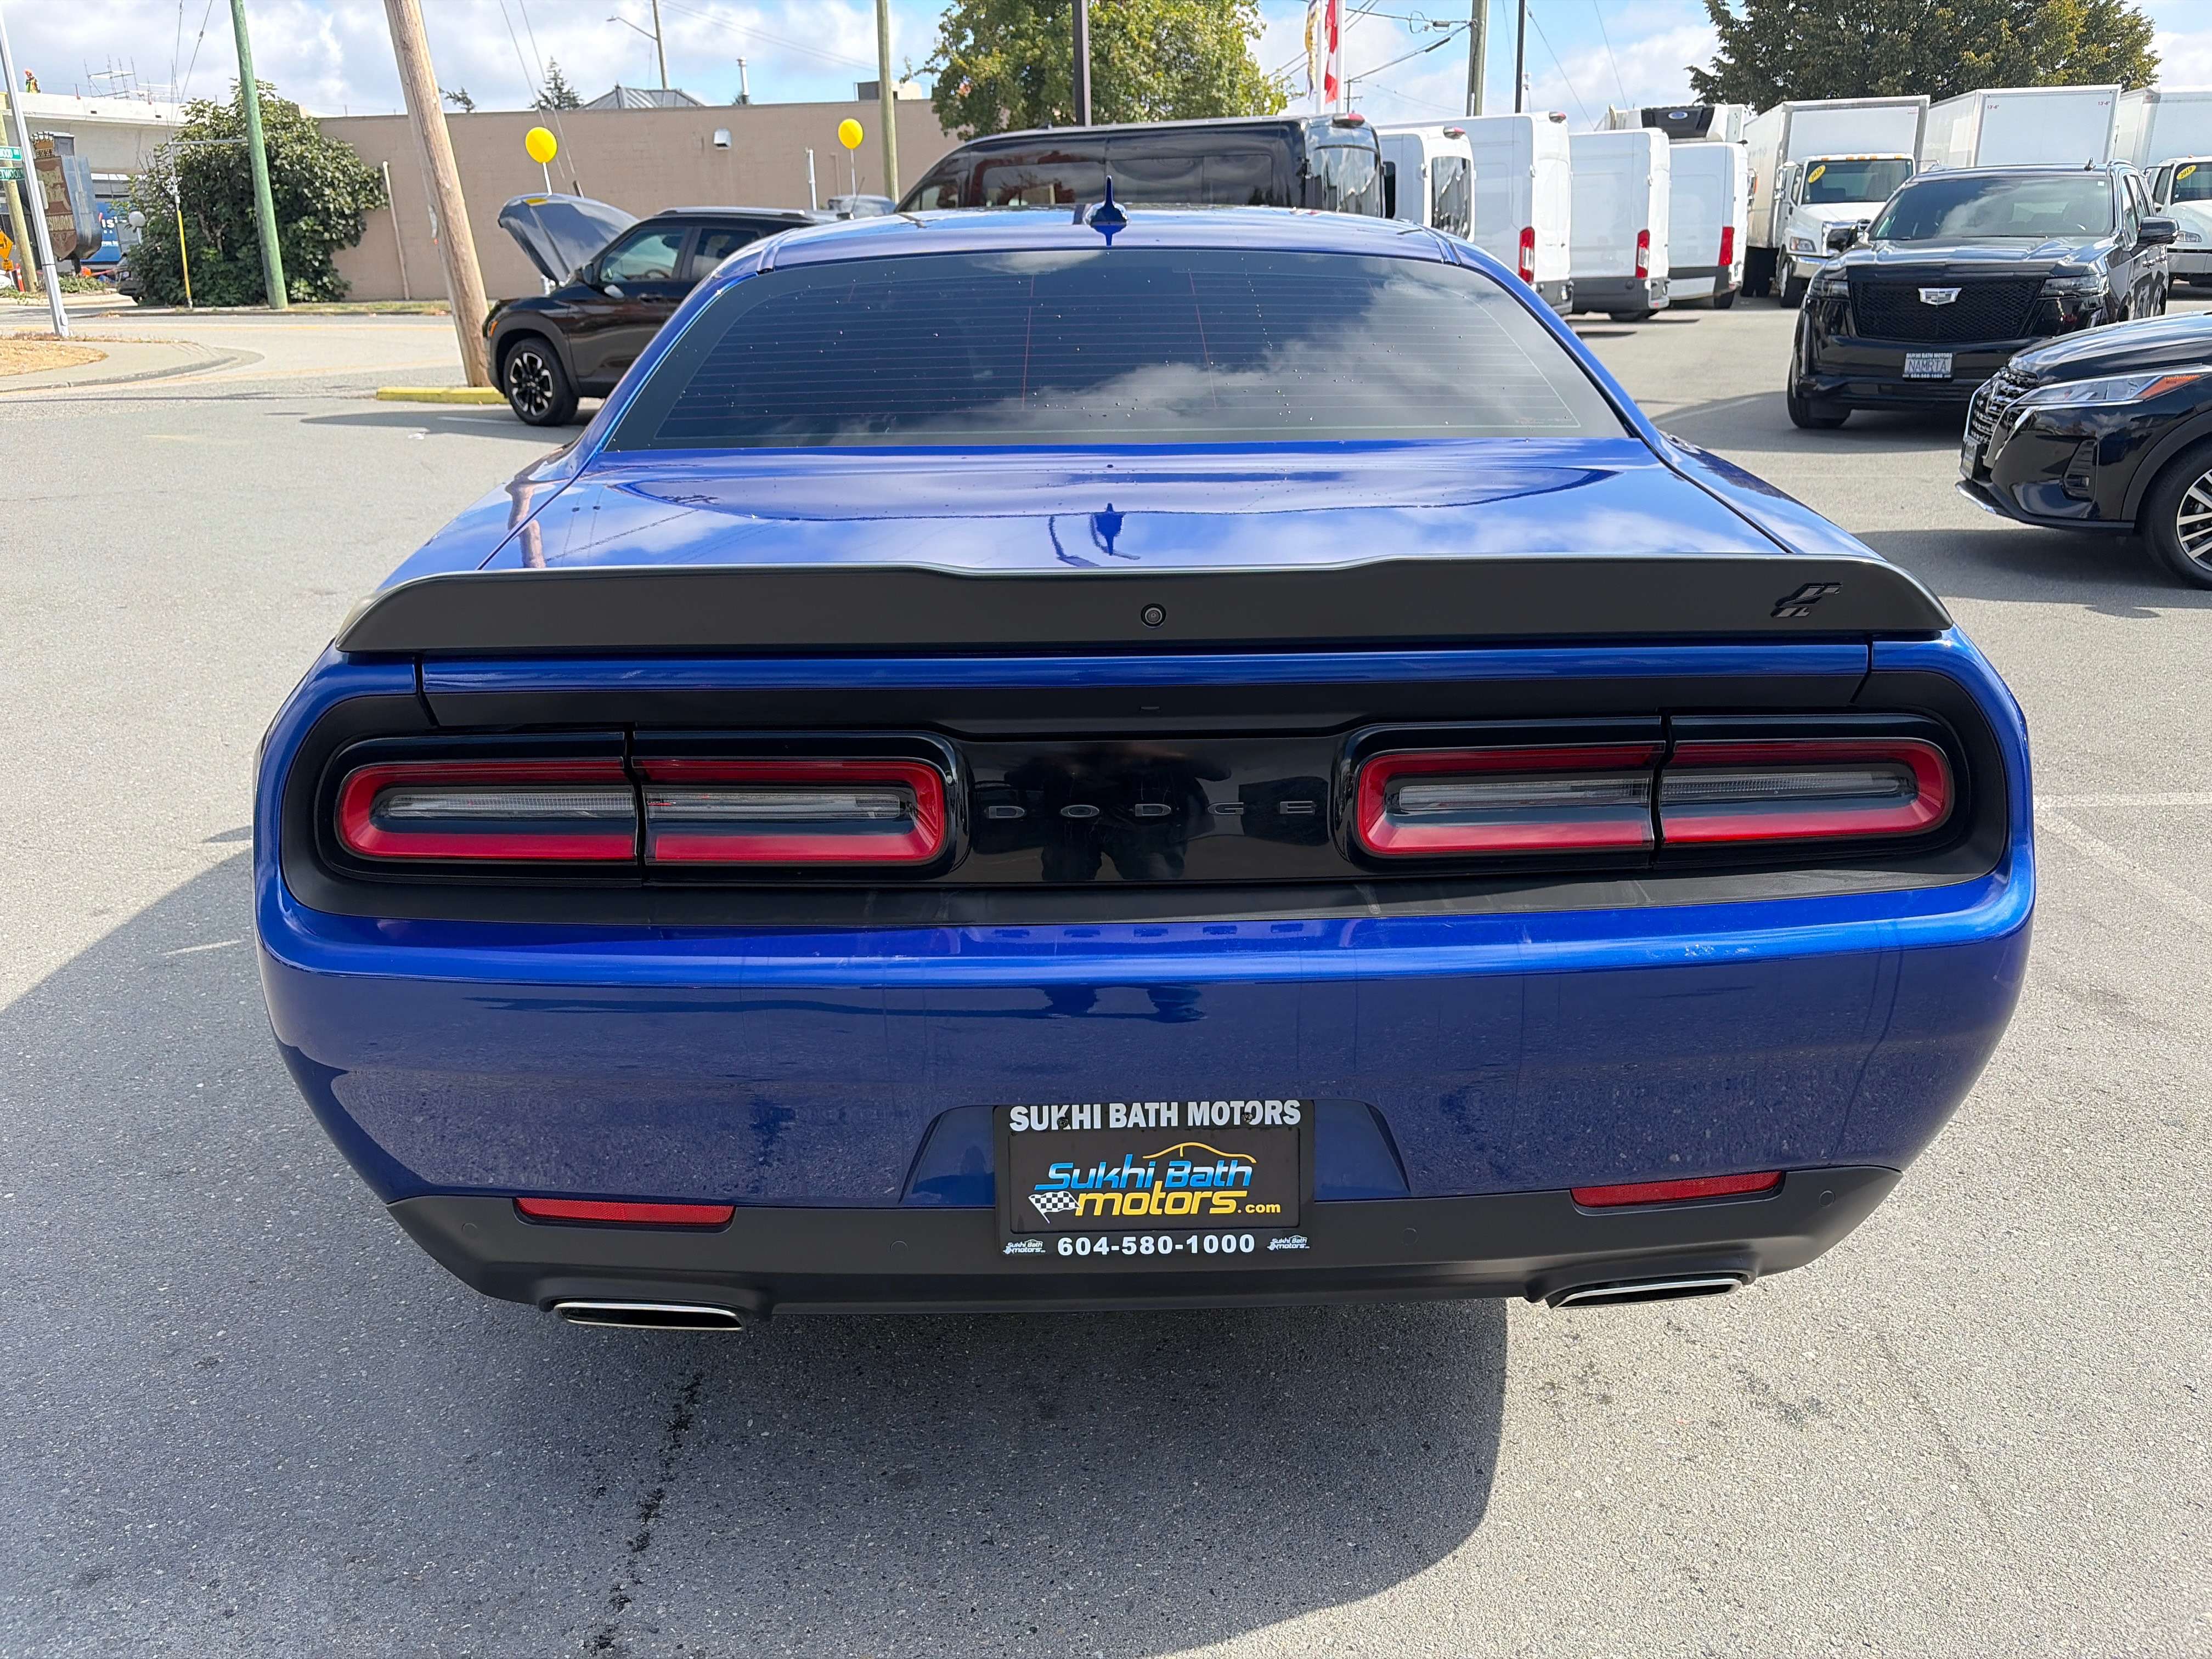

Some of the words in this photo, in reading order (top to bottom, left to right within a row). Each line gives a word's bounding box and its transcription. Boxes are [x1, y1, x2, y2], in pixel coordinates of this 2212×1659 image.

[2181, 166, 2192, 178] 2019
[987, 800, 1316, 819] DODGE
[1009, 1104, 1102, 1131] SUKHI
[1109, 1102, 1179, 1128] BATH
[1187, 1099, 1301, 1126] MOTORS
[1034, 1154, 1156, 1190] Sukhi
[1165, 1159, 1254, 1188] Bath
[1057, 1234, 1255, 1256] 604-580-1000
